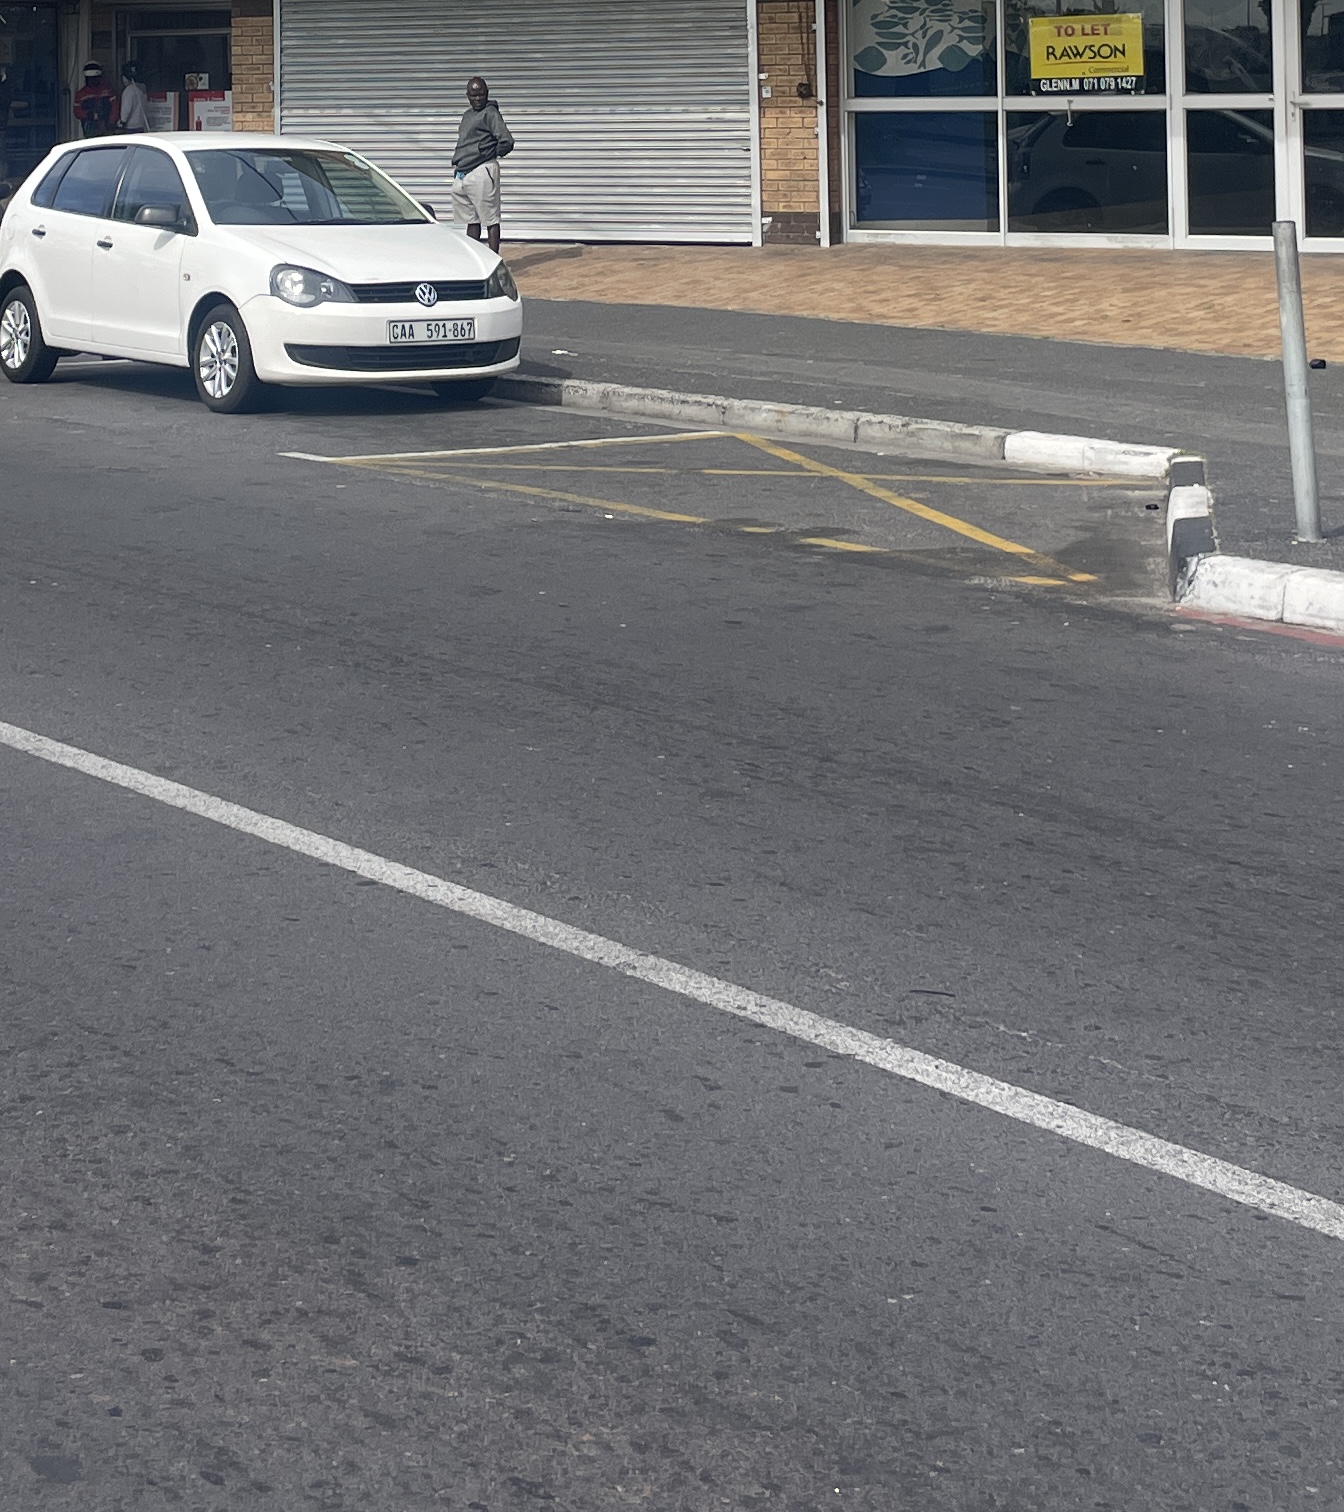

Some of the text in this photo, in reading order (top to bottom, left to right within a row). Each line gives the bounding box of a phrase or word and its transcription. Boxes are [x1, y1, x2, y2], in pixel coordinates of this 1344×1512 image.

[1054, 23, 1110, 37] TO LET
[1046, 43, 1126, 61] RAWSON
[1088, 65, 1129, 74] Commercial
[1083, 78, 1098, 90] 071
[1100, 78, 1115, 90] 079
[1116, 77, 1136, 89] 1427
[392, 324, 414, 339] CAA
